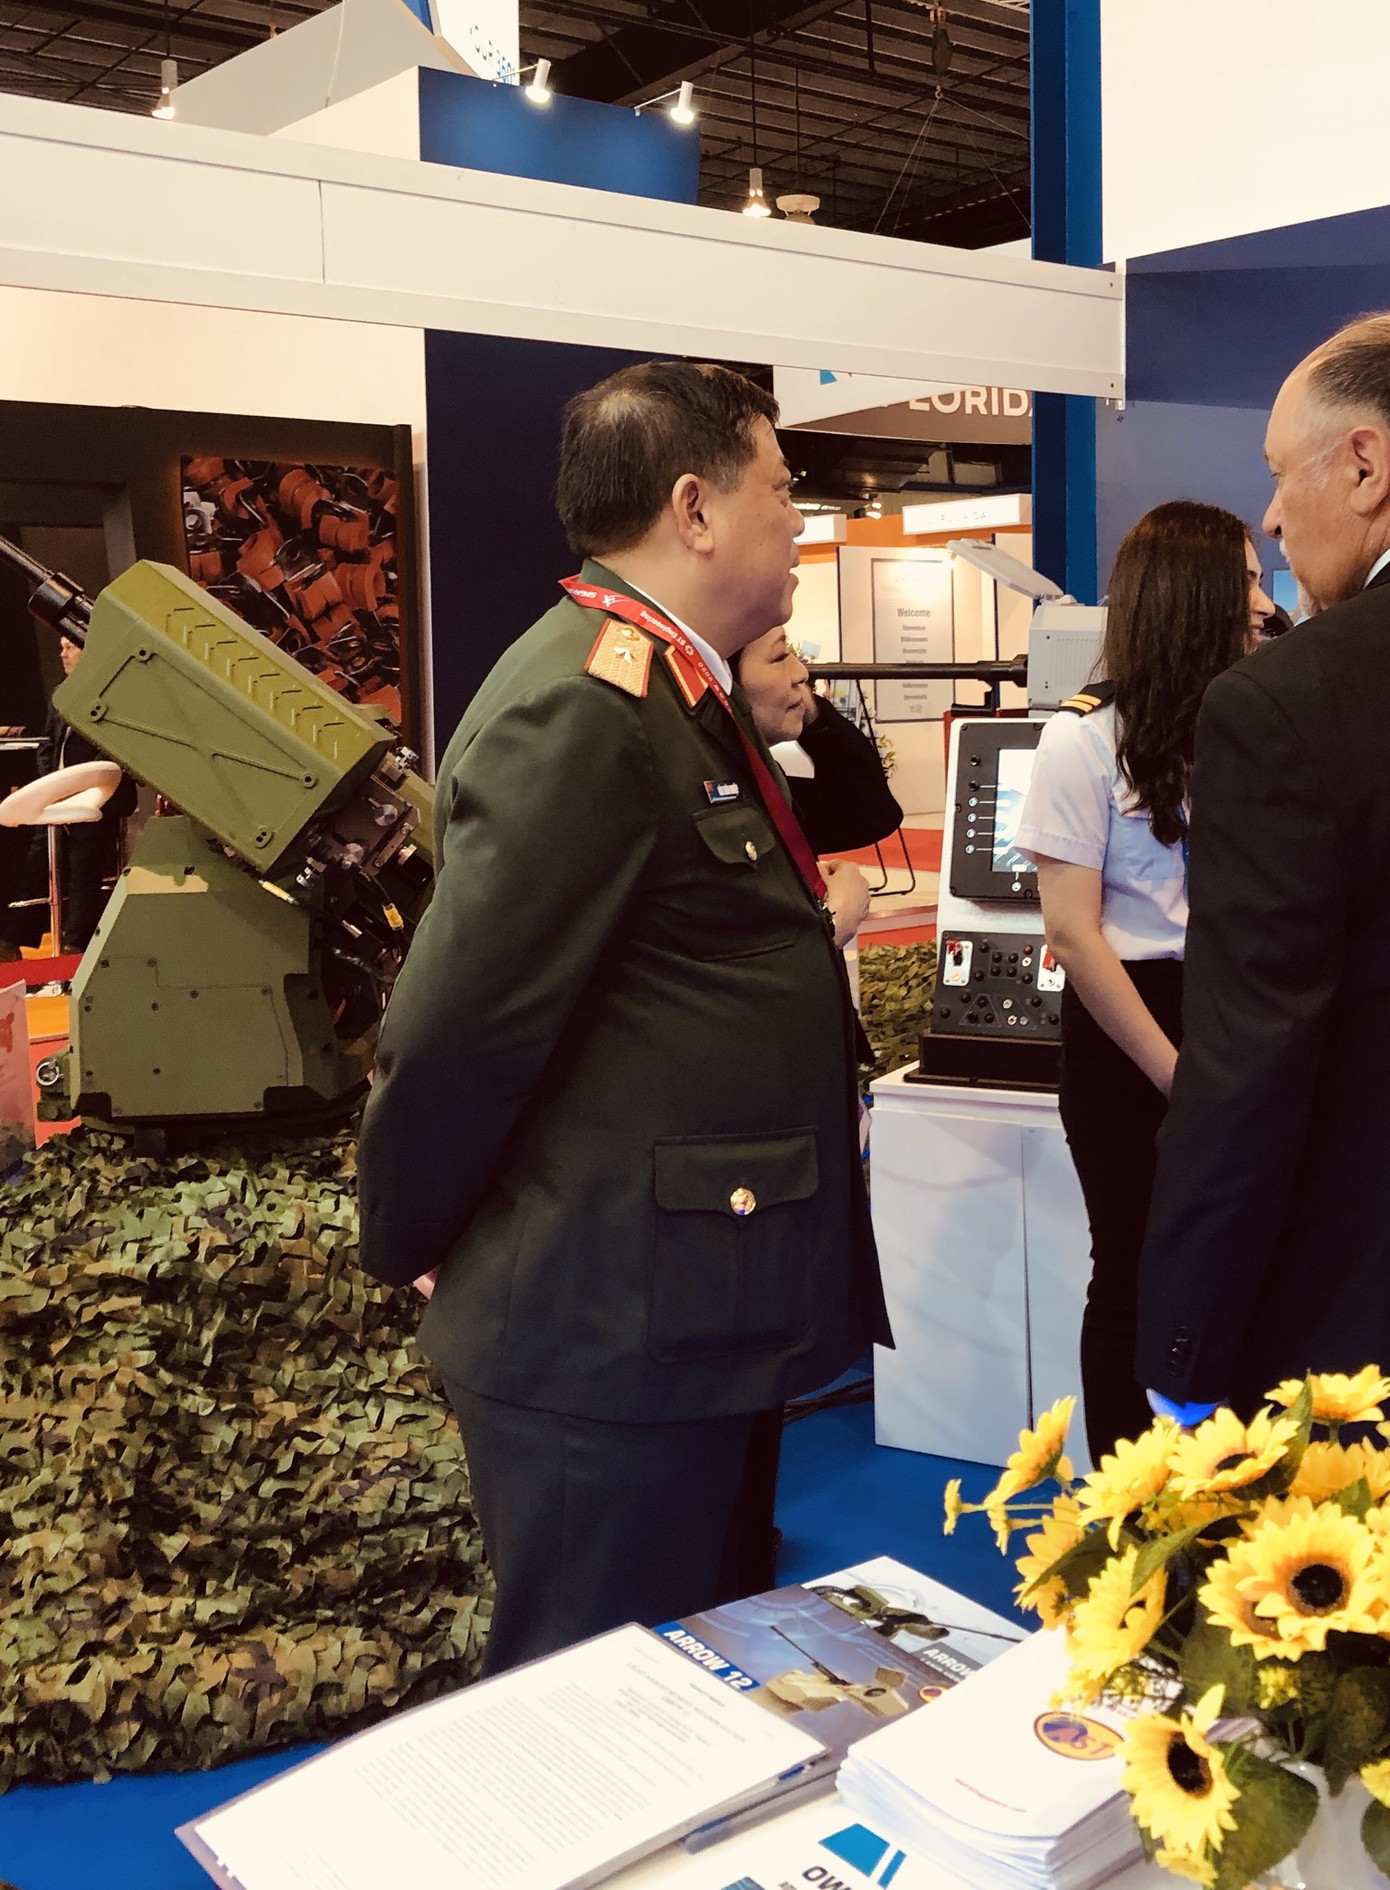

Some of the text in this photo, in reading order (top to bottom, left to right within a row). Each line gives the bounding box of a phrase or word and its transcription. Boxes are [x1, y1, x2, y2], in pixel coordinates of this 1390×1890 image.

[882, 386, 1034, 417] LORID
[640, 610, 679, 639] Engineering
[896, 608, 931, 618] Welcome
[663, 1629, 730, 1671] ARROW
[723, 1671, 753, 1690] 12
